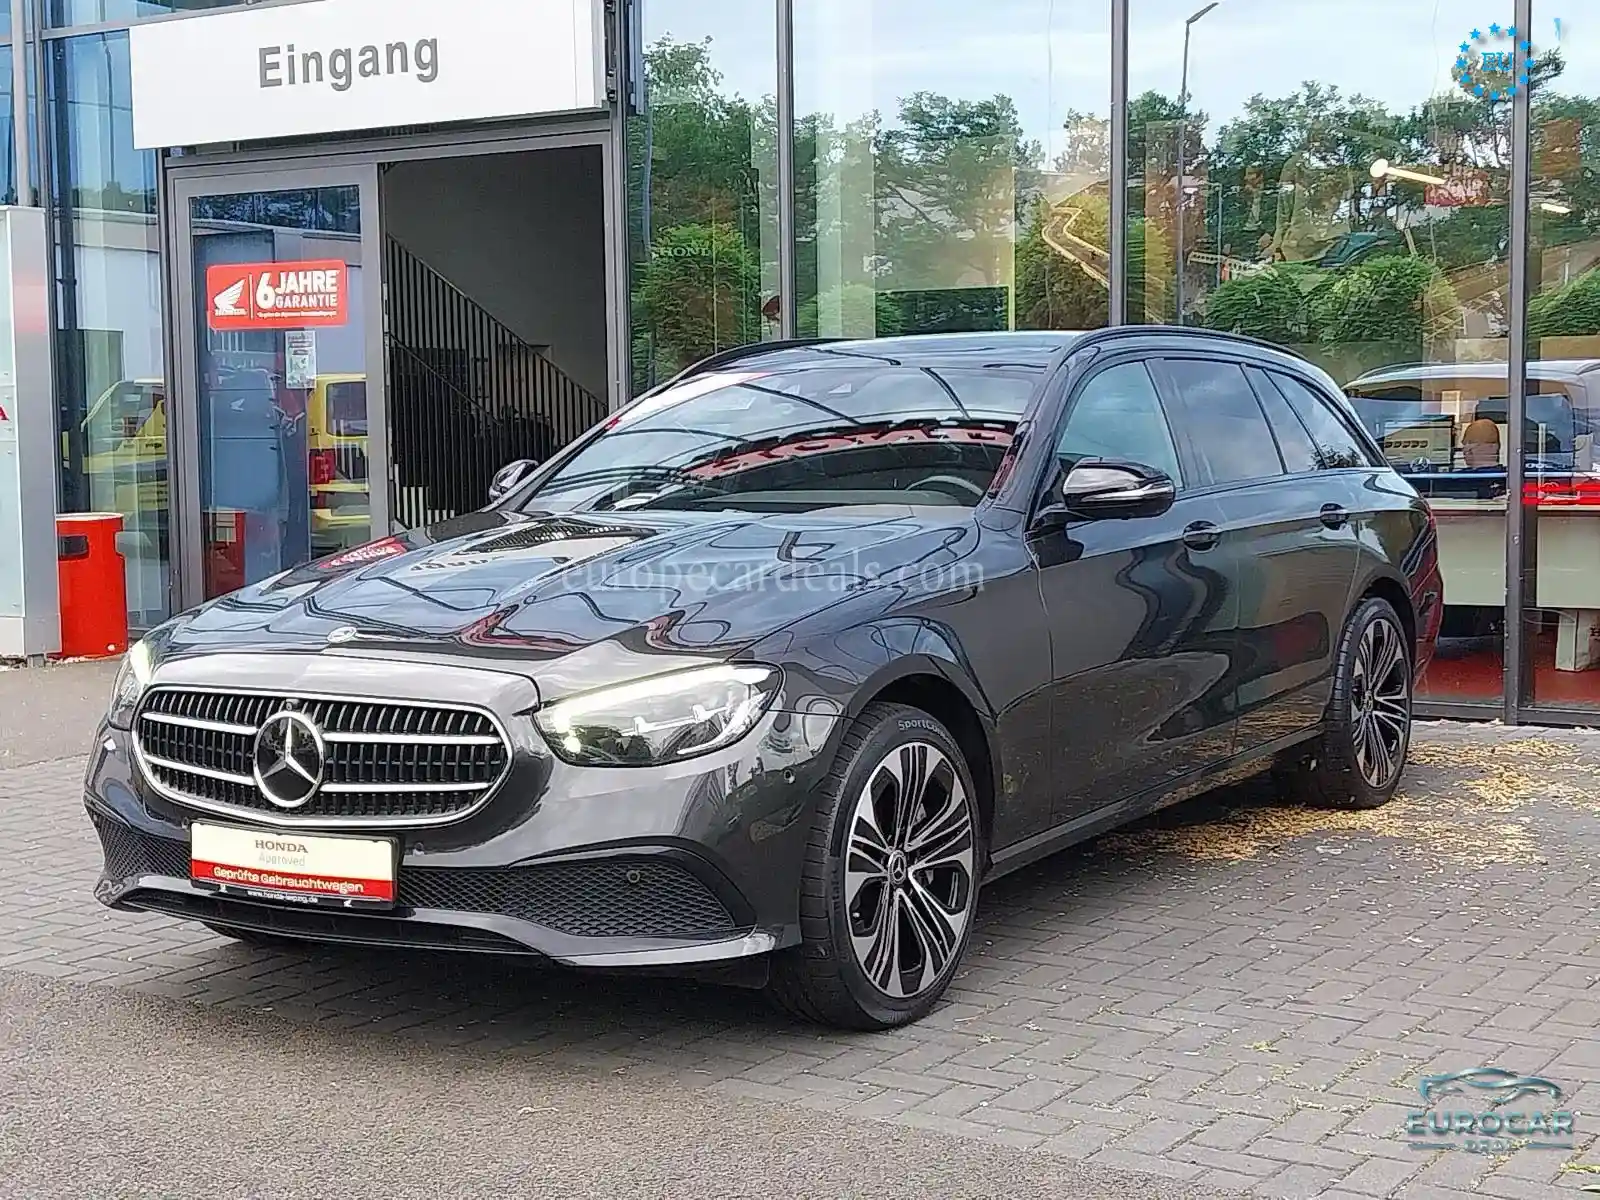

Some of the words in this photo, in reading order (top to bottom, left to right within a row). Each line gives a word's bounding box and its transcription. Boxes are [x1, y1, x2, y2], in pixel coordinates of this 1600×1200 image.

[258, 37, 439, 92] Eingang
[256, 271, 276, 309] 6
[275, 293, 338, 308] GARANTIE
[255, 839, 309, 854] HONDA
[259, 852, 305, 867] Approved
[213, 866, 260, 883] Geprüfte
[260, 872, 364, 895] Gebrauchtwagen
